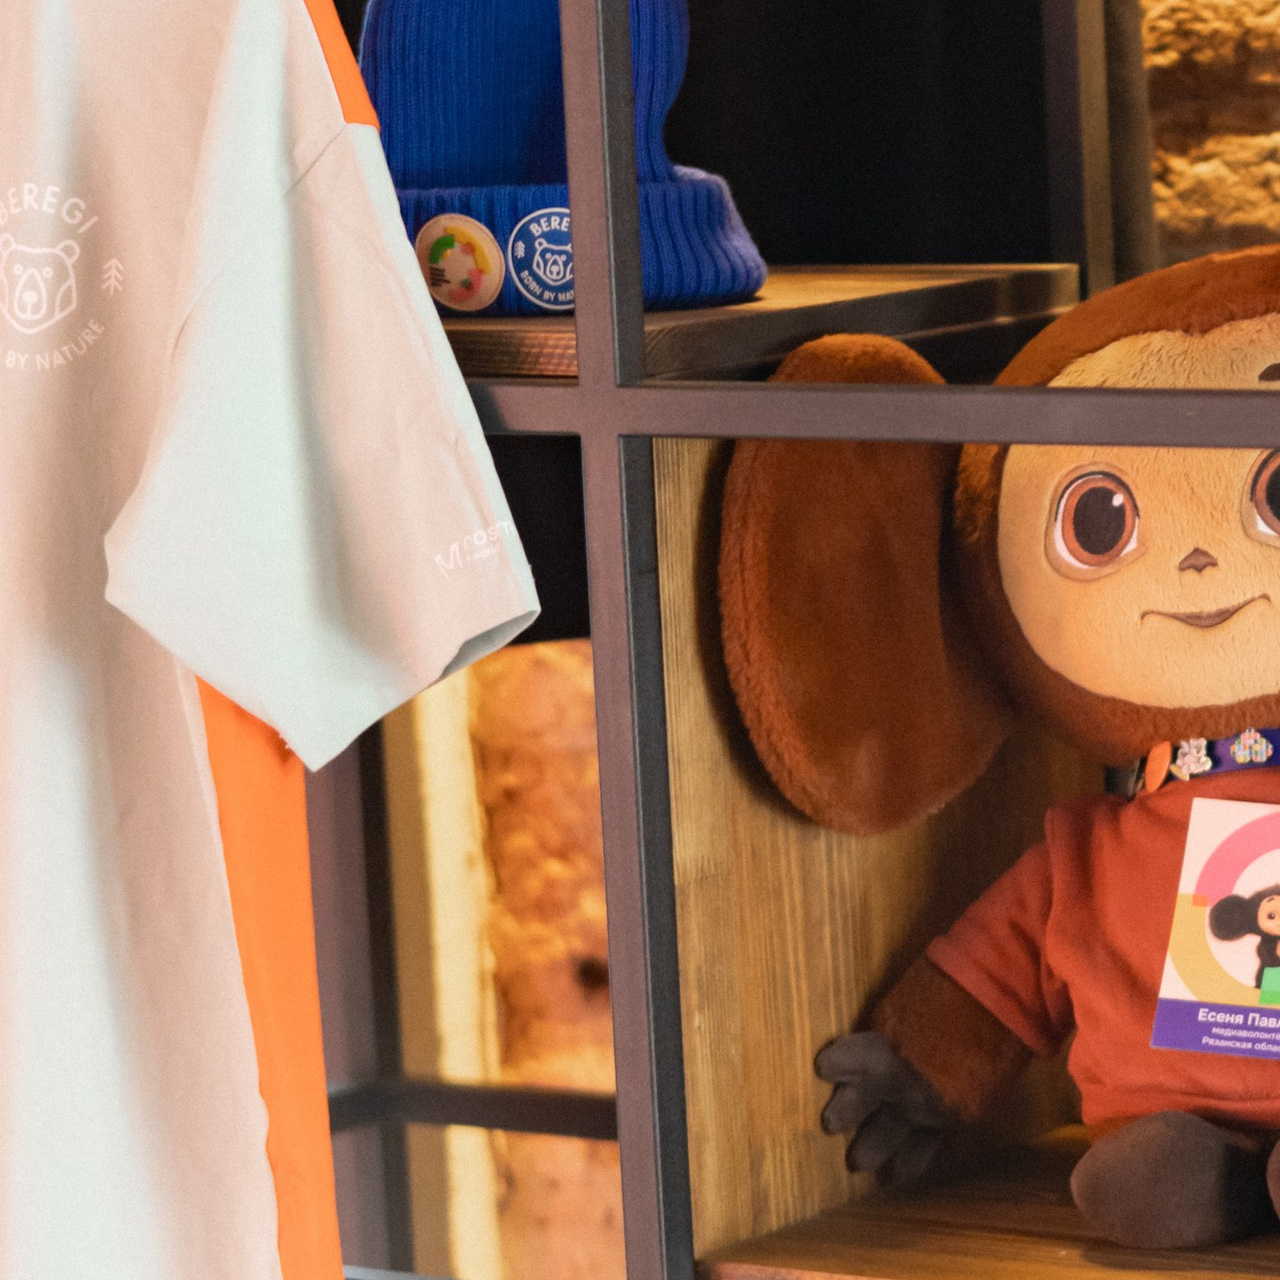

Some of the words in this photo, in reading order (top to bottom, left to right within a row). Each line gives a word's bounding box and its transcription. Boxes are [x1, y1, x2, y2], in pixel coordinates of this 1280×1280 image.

[529, 215, 571, 237] BERE
[543, 291, 556, 302] BY
[5, 349, 28, 371] BY
[35, 318, 106, 372] NATURE
[1198, 1007, 1244, 1025] Есеня
[1202, 1035, 1252, 1050] Рязанская
